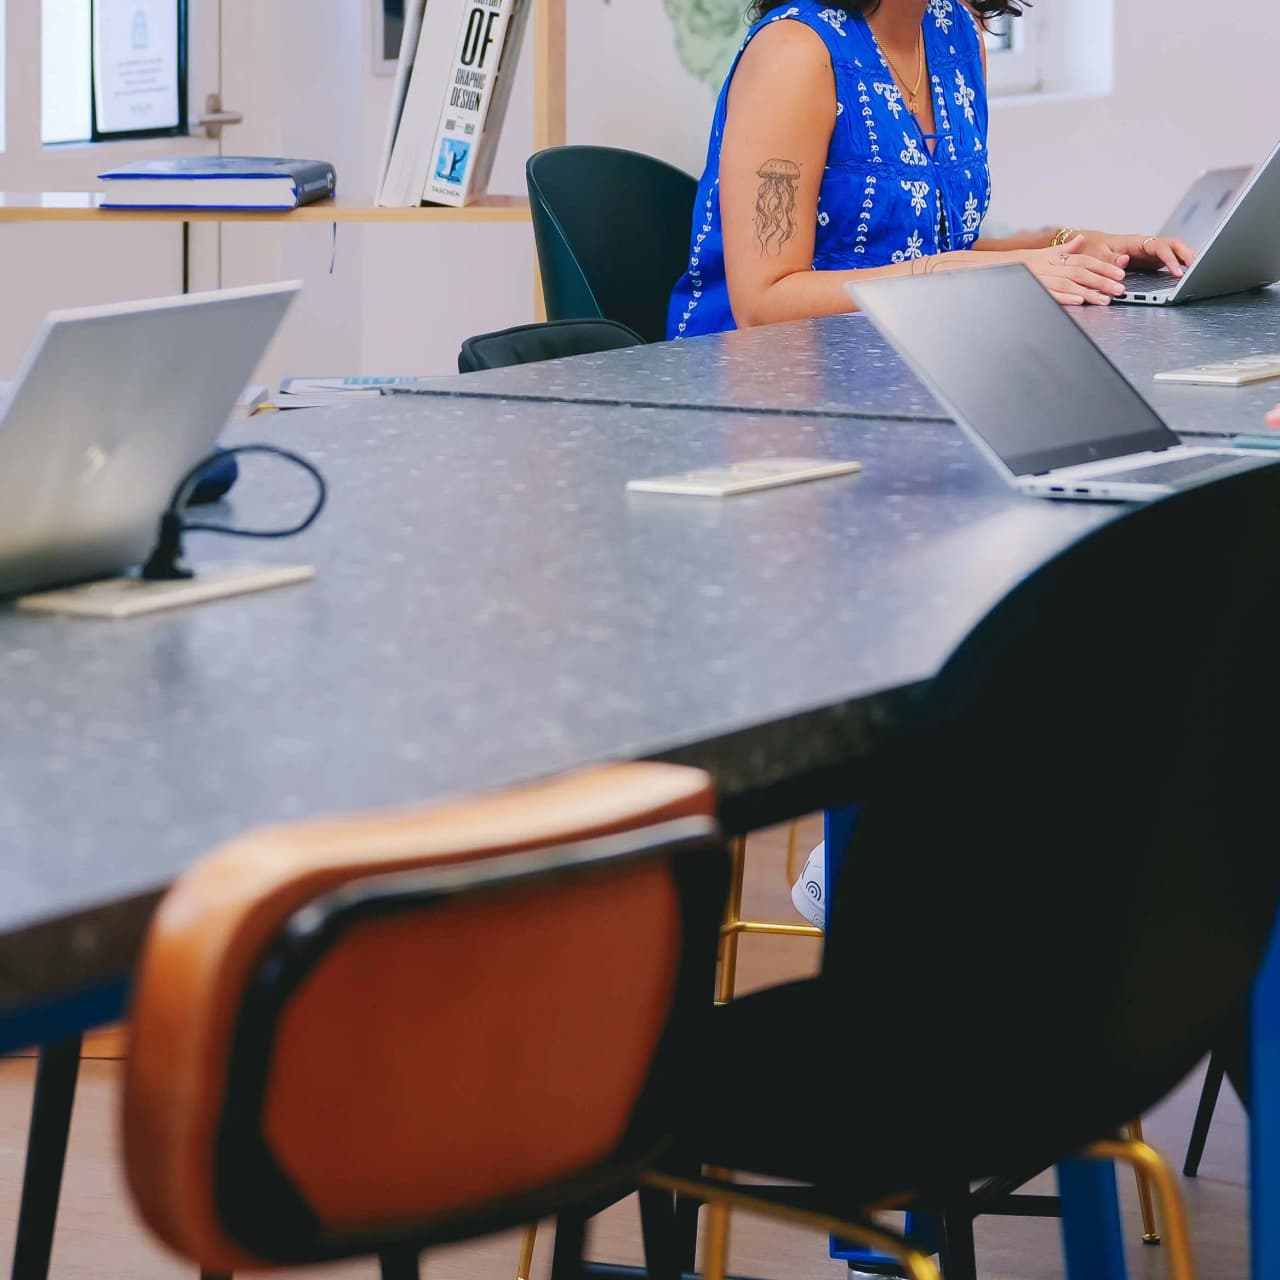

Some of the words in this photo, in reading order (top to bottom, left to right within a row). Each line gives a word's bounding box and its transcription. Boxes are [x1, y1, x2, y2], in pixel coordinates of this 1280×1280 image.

[460, 8, 500, 68] OF
[455, 68, 487, 90] GRAPHIC
[450, 86, 482, 112] DESIGN
